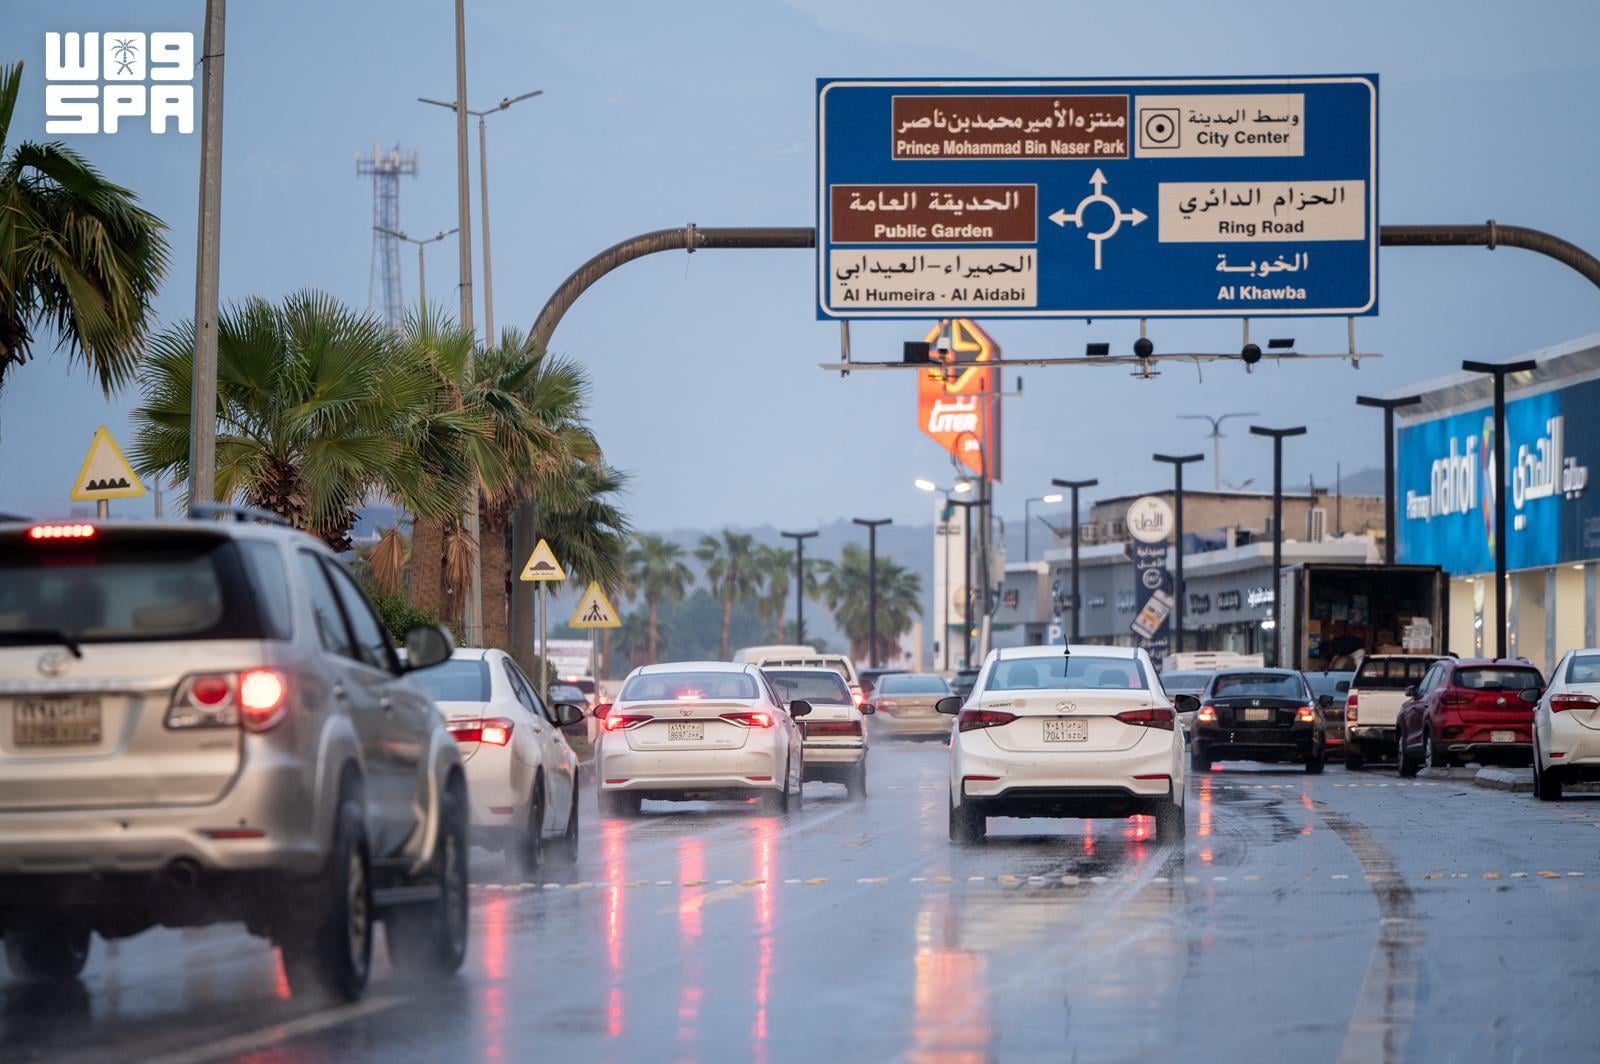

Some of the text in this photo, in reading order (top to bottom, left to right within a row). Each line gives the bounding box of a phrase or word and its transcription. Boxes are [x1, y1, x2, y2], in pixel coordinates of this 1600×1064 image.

[897, 100, 1125, 133] منتزه الأمير محمد بن ناصر
[1188, 108, 1299, 128] وسط المدينة
[897, 139, 1125, 155] Prince Mohammad Bin Naser Park
[1196, 130, 1290, 148] City Center
[849, 190, 1019, 216] الحديقة العامة
[1178, 186, 1345, 220] الحزام الدائري
[873, 223, 993, 238] Public Garden
[1218, 219, 1304, 237] Ring Road
[1215, 251, 1308, 278] الخوبة
[843, 288, 860, 301] Al
[865, 288, 936, 302] Humeira
[951, 288, 968, 301] Al
[972, 287, 1026, 302] Aidabi
[1217, 285, 1307, 300] Al Khawba
[1431, 434, 1478, 516] nahdi
[1045, 731, 1065, 741] 7041
